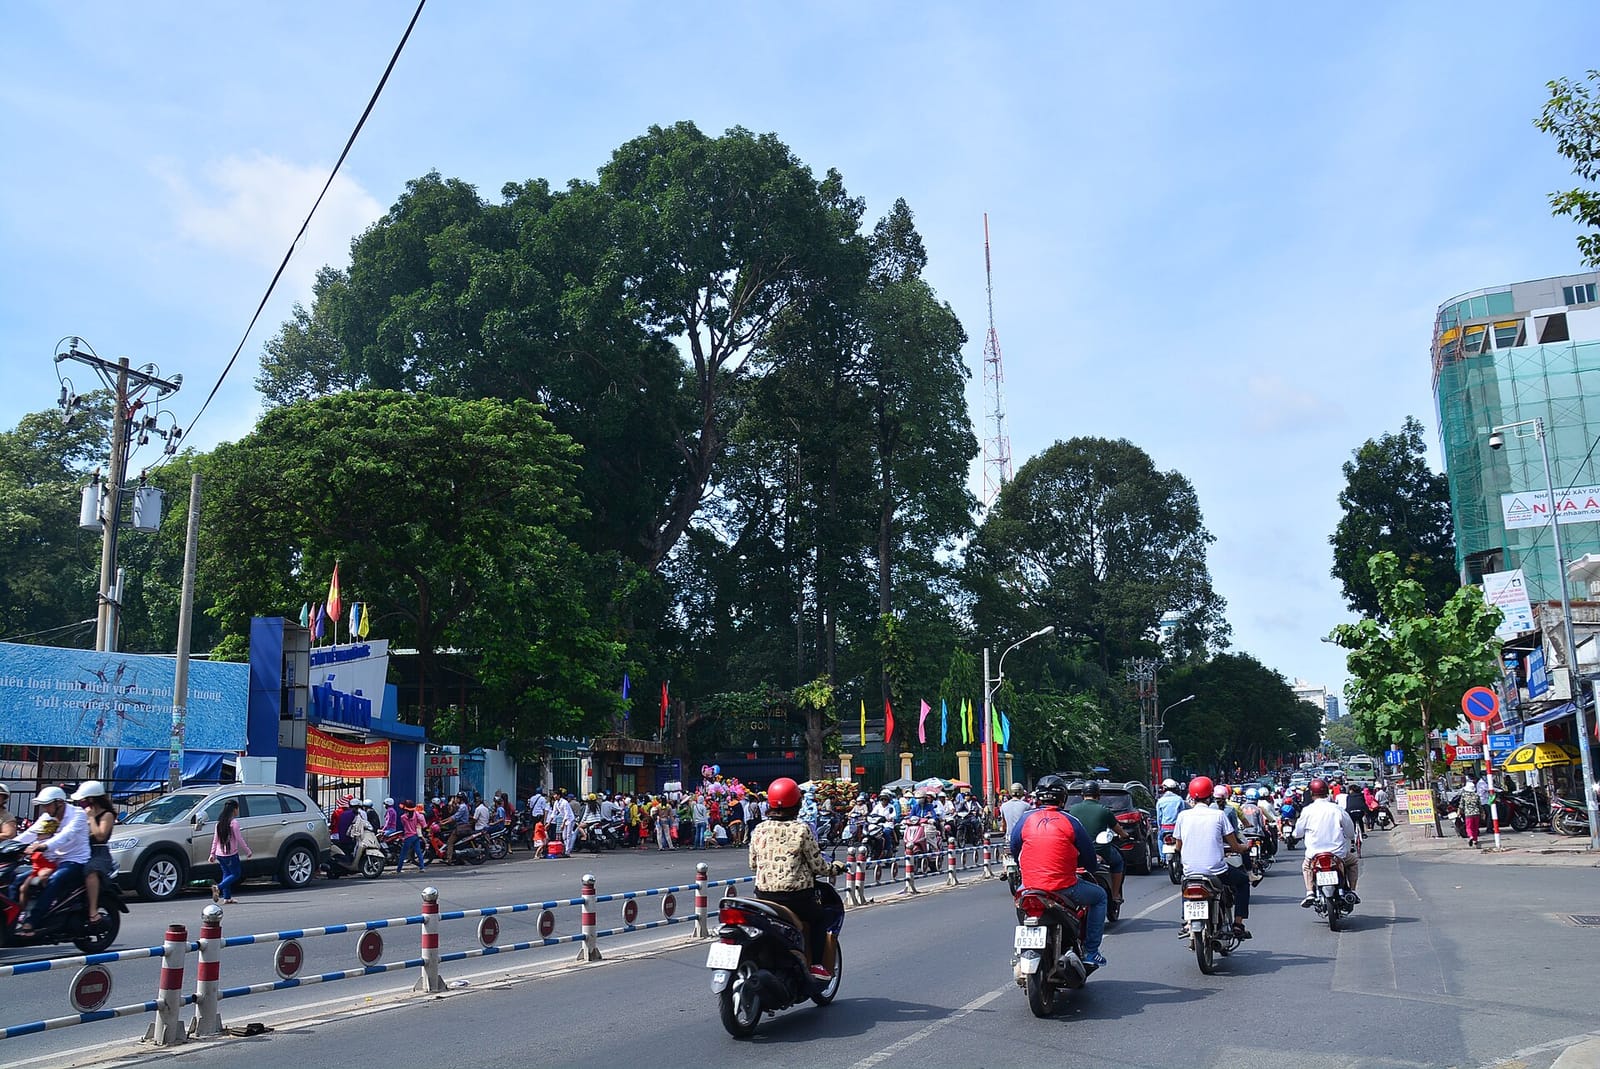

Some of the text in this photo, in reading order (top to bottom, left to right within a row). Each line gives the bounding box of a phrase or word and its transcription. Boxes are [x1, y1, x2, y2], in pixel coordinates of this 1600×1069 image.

[63, 698, 110, 711] services
[114, 700, 130, 712] for
[446, 767, 459, 776] XE
